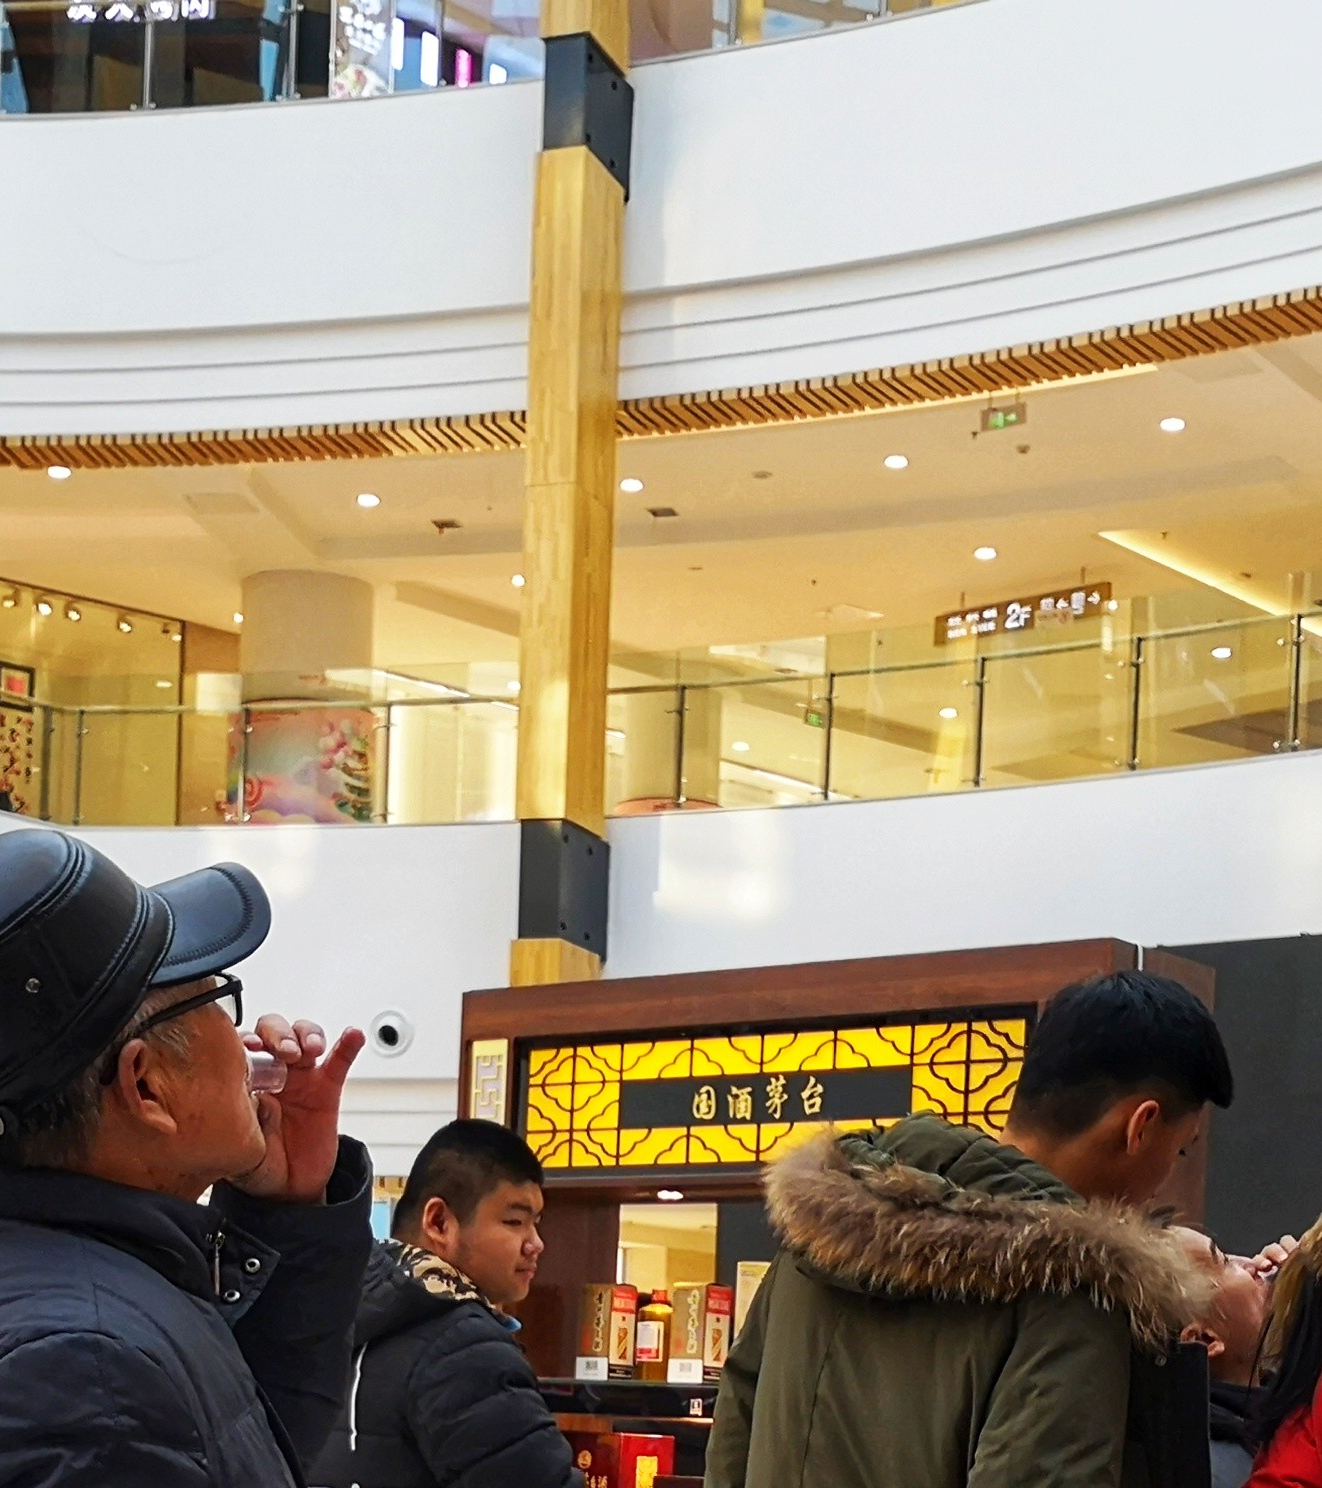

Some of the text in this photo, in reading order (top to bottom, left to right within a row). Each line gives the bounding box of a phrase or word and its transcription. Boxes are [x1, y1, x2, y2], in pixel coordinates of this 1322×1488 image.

[1004, 602, 1032, 629] 2F
[692, 1074, 824, 1120] 国酒茅台
